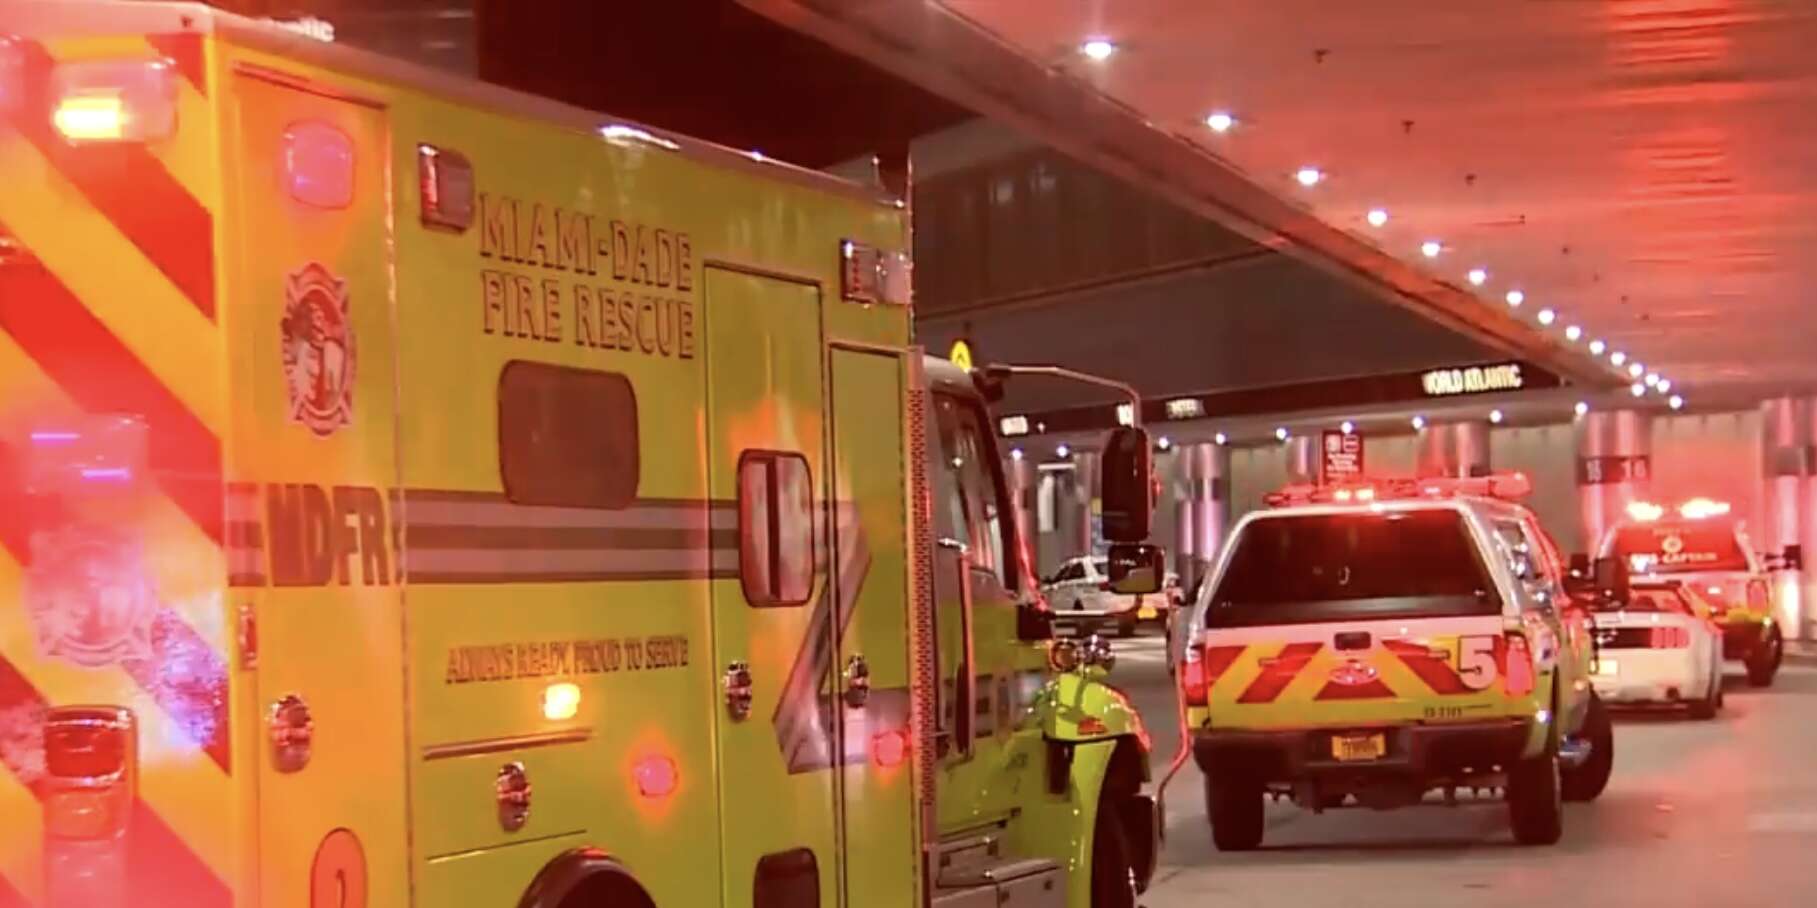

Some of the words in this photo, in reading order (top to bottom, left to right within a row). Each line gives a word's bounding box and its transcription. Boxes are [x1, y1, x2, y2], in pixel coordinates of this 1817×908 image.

[477, 192, 692, 292] MIAMI-DADE
[480, 268, 562, 342] FIRE
[573, 283, 694, 360] RESCUE
[1464, 364, 1523, 393] ATLANTIC
[446, 645, 514, 685] ALWAYS
[573, 638, 620, 674] PROUD
[623, 636, 643, 671] TO
[645, 634, 688, 670] SERVE
[1456, 634, 1500, 691] 5
